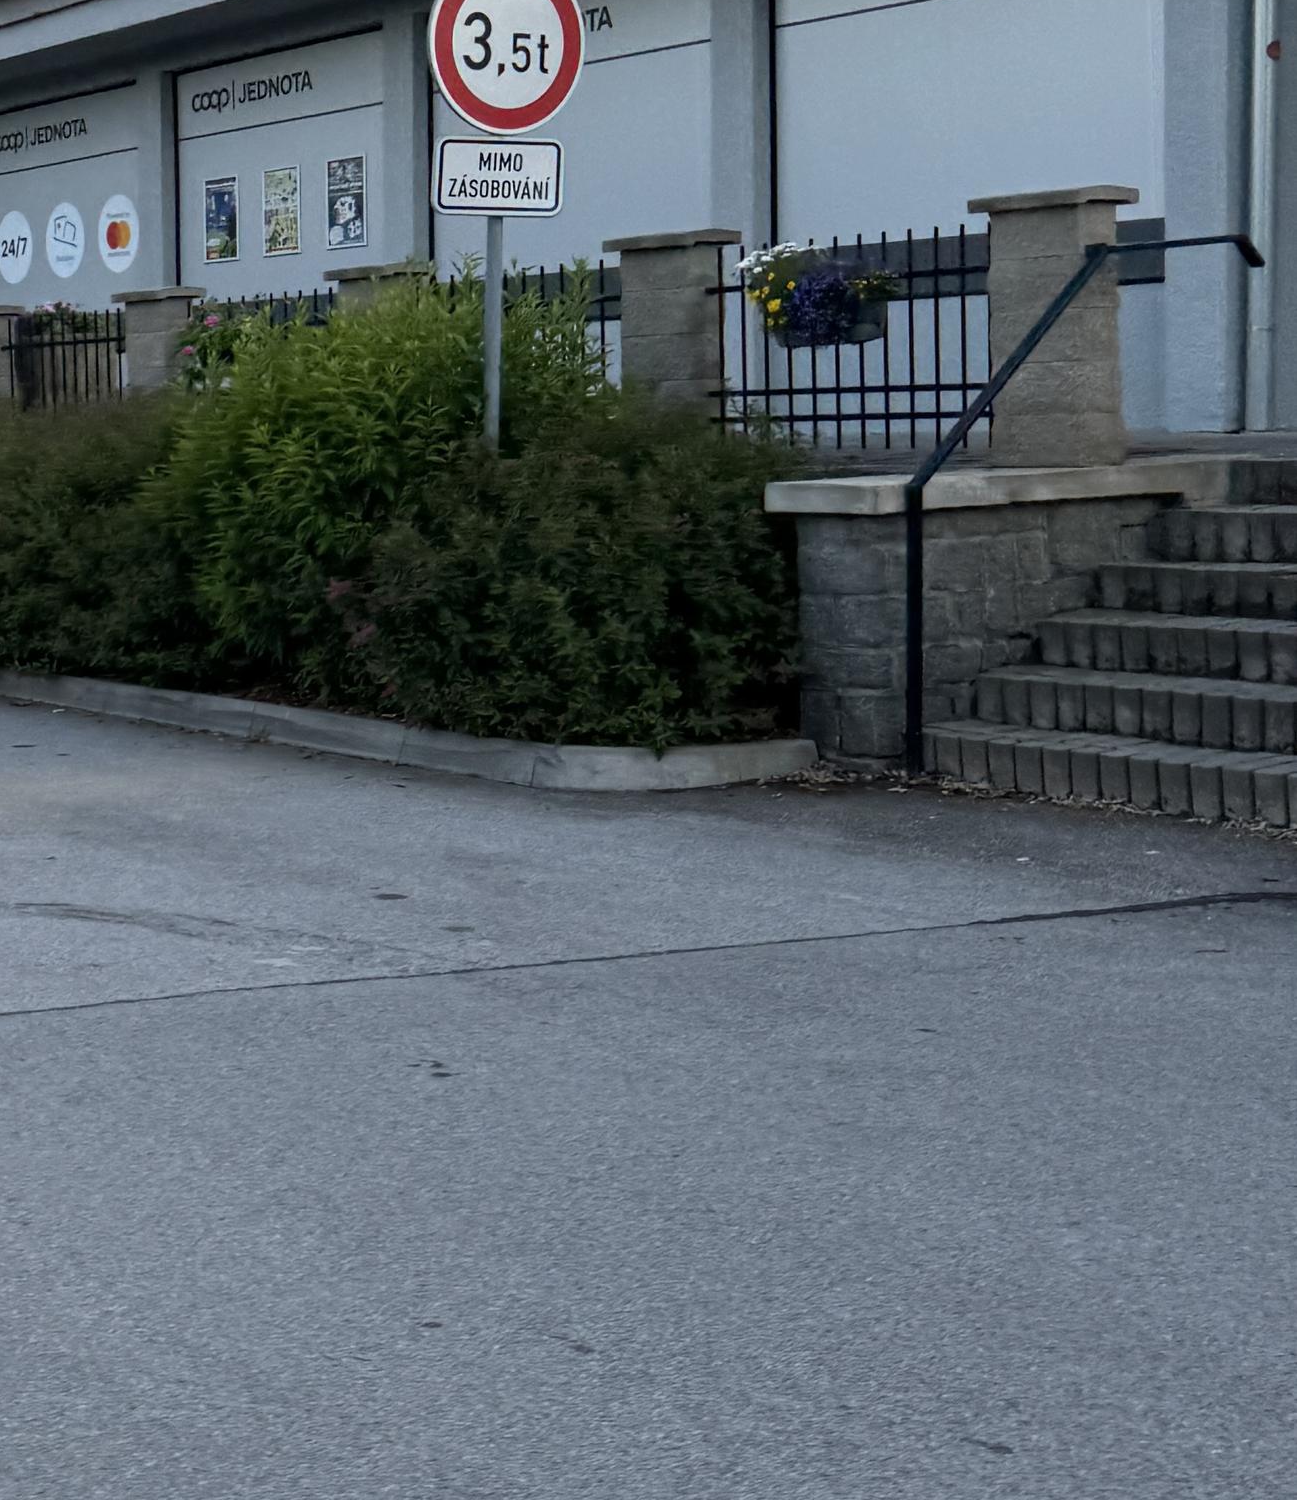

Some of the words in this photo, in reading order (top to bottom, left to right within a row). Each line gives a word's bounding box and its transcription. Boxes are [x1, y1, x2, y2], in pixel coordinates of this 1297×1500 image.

[191, 87, 230, 113] coop
[238, 70, 313, 104] JEDNOTA
[30, 118, 87, 147] JEDNOTA
[478, 152, 523, 173] MIMO
[448, 174, 550, 200] ZÁSOBOVÁNÍ
[1, 236, 28, 259] 24/7
